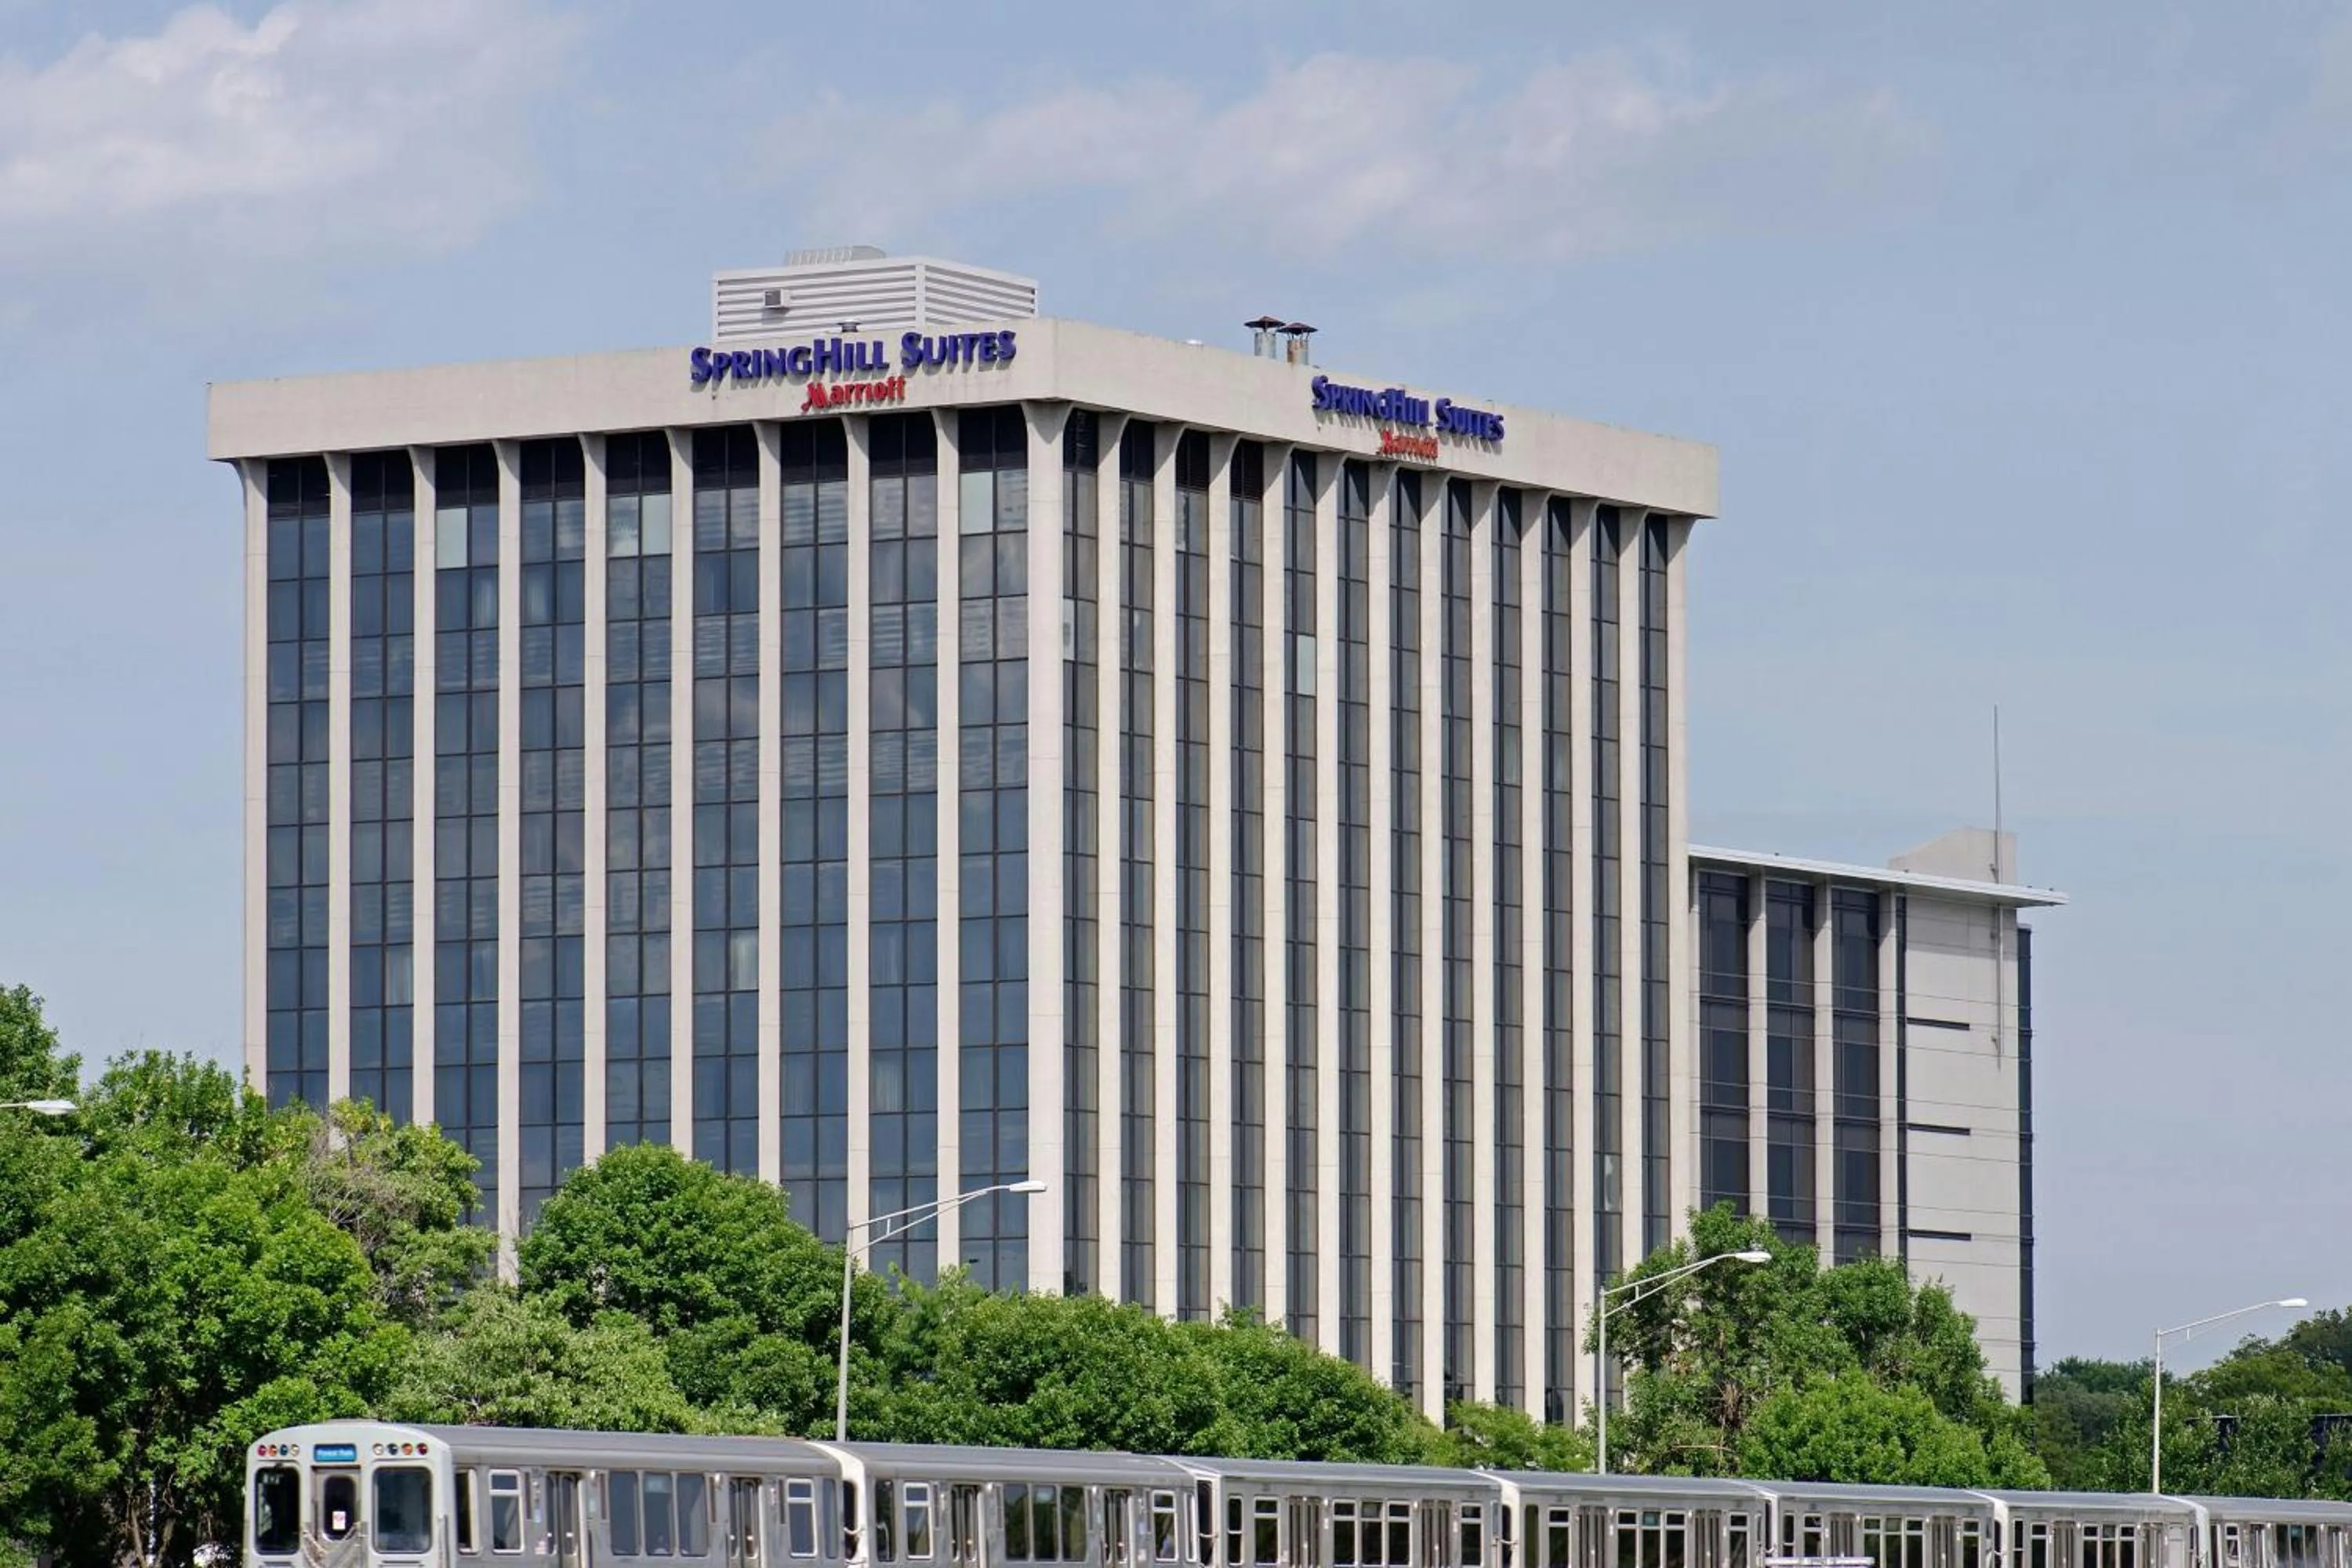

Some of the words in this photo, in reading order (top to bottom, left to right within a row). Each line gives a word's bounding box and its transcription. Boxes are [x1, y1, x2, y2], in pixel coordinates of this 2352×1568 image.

[691, 338, 890, 383] SPRINGHILL
[902, 331, 1017, 368] SUITES
[801, 376, 905, 412] Marriott
[1436, 397, 1505, 441] SUITES
